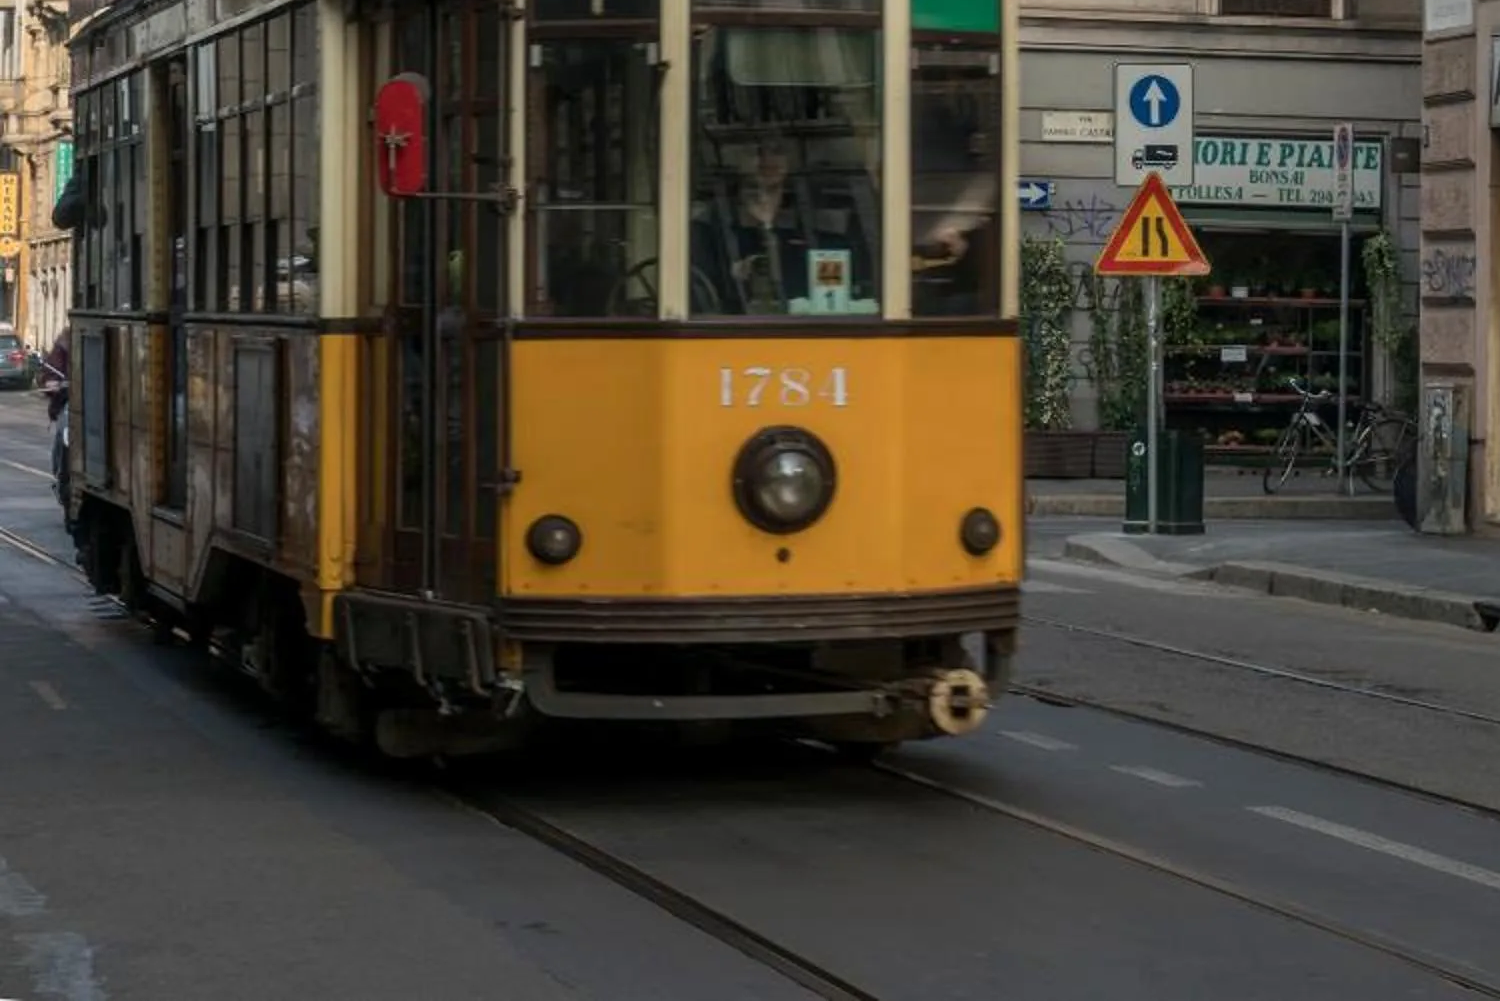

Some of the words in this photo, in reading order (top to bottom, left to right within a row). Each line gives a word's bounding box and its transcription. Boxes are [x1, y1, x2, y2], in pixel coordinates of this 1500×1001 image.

[1194, 139, 1249, 166] IORI
[1255, 141, 1271, 167] E
[1249, 170, 1305, 187] BONSAI
[719, 366, 849, 406] 1784
